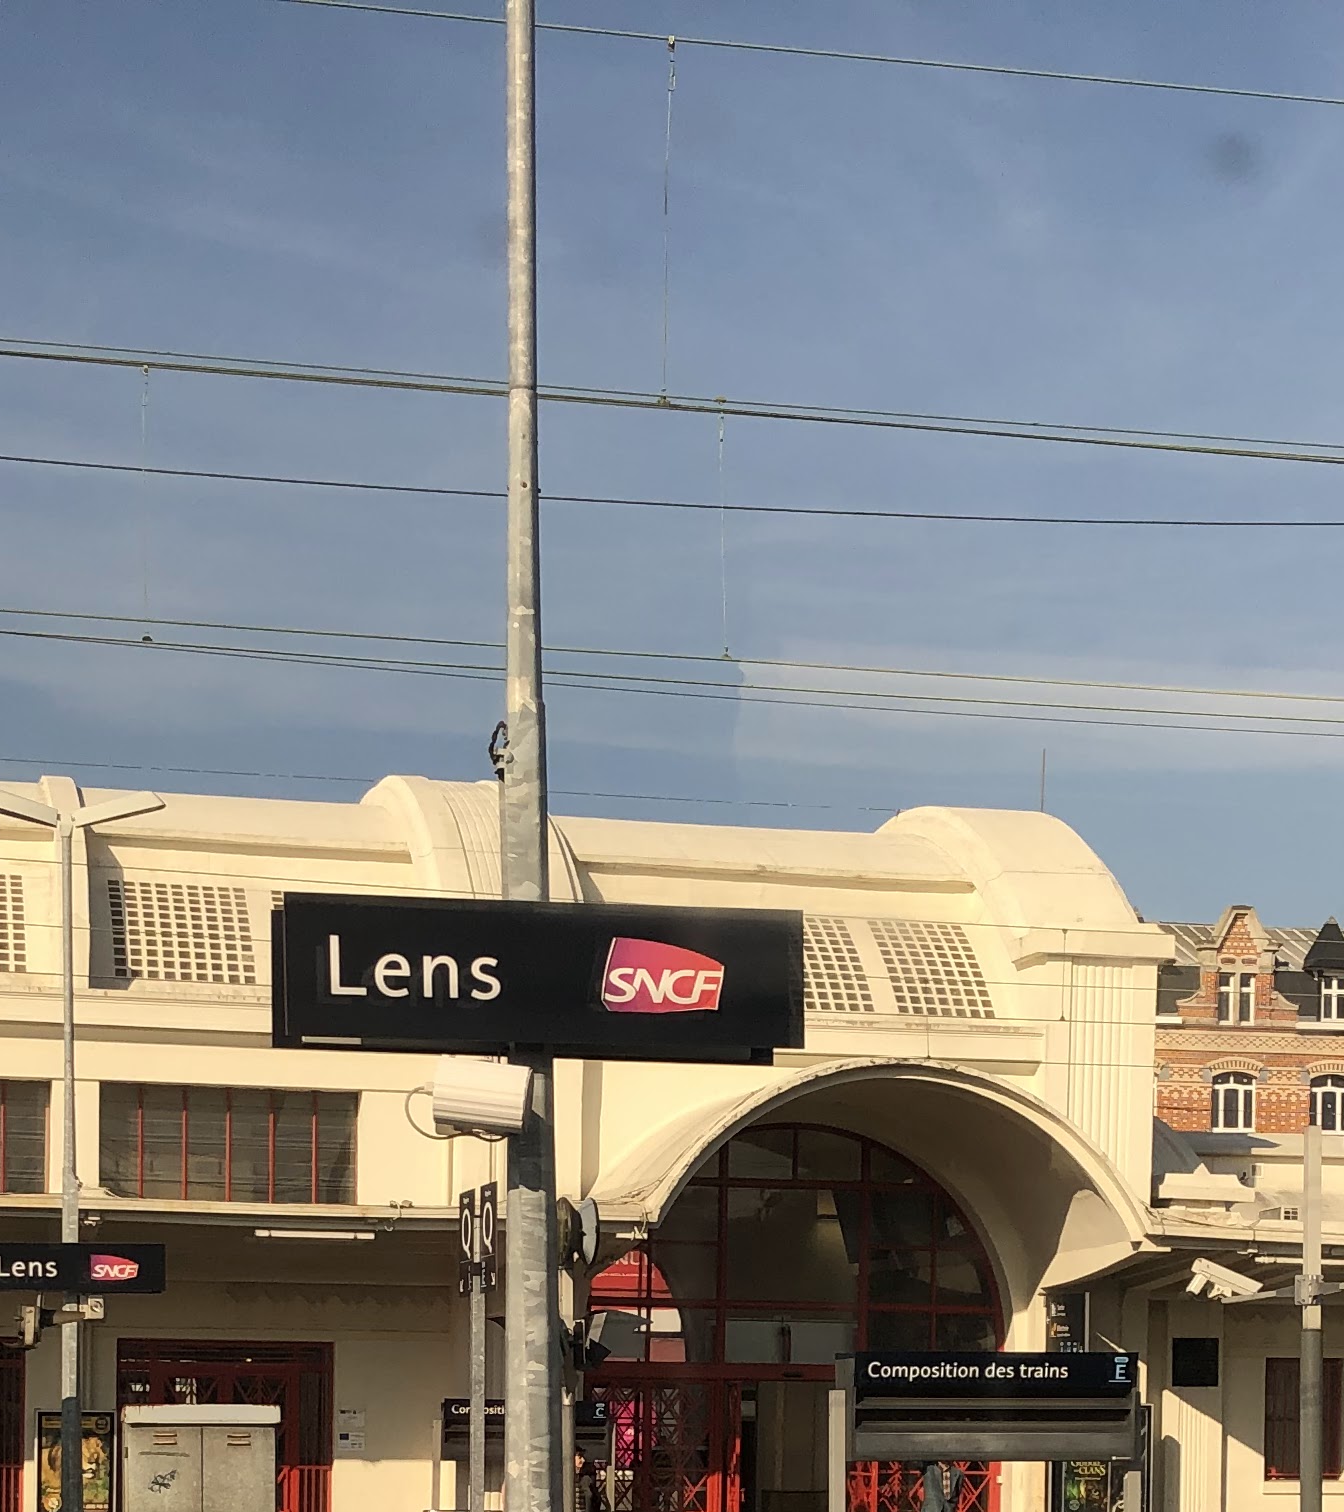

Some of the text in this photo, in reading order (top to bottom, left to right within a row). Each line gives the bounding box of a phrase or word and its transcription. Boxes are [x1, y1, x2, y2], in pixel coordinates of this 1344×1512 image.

[329, 934, 502, 1001] Lens
[604, 967, 722, 1004] SNCF
[461, 1207, 472, 1260] Q
[481, 1201, 493, 1254] Q
[92, 1264, 138, 1278] SNCF
[867, 1361, 1069, 1382] Composition des trains
[1115, 1364, 1127, 1380] E
[595, 1407, 605, 1417] C
